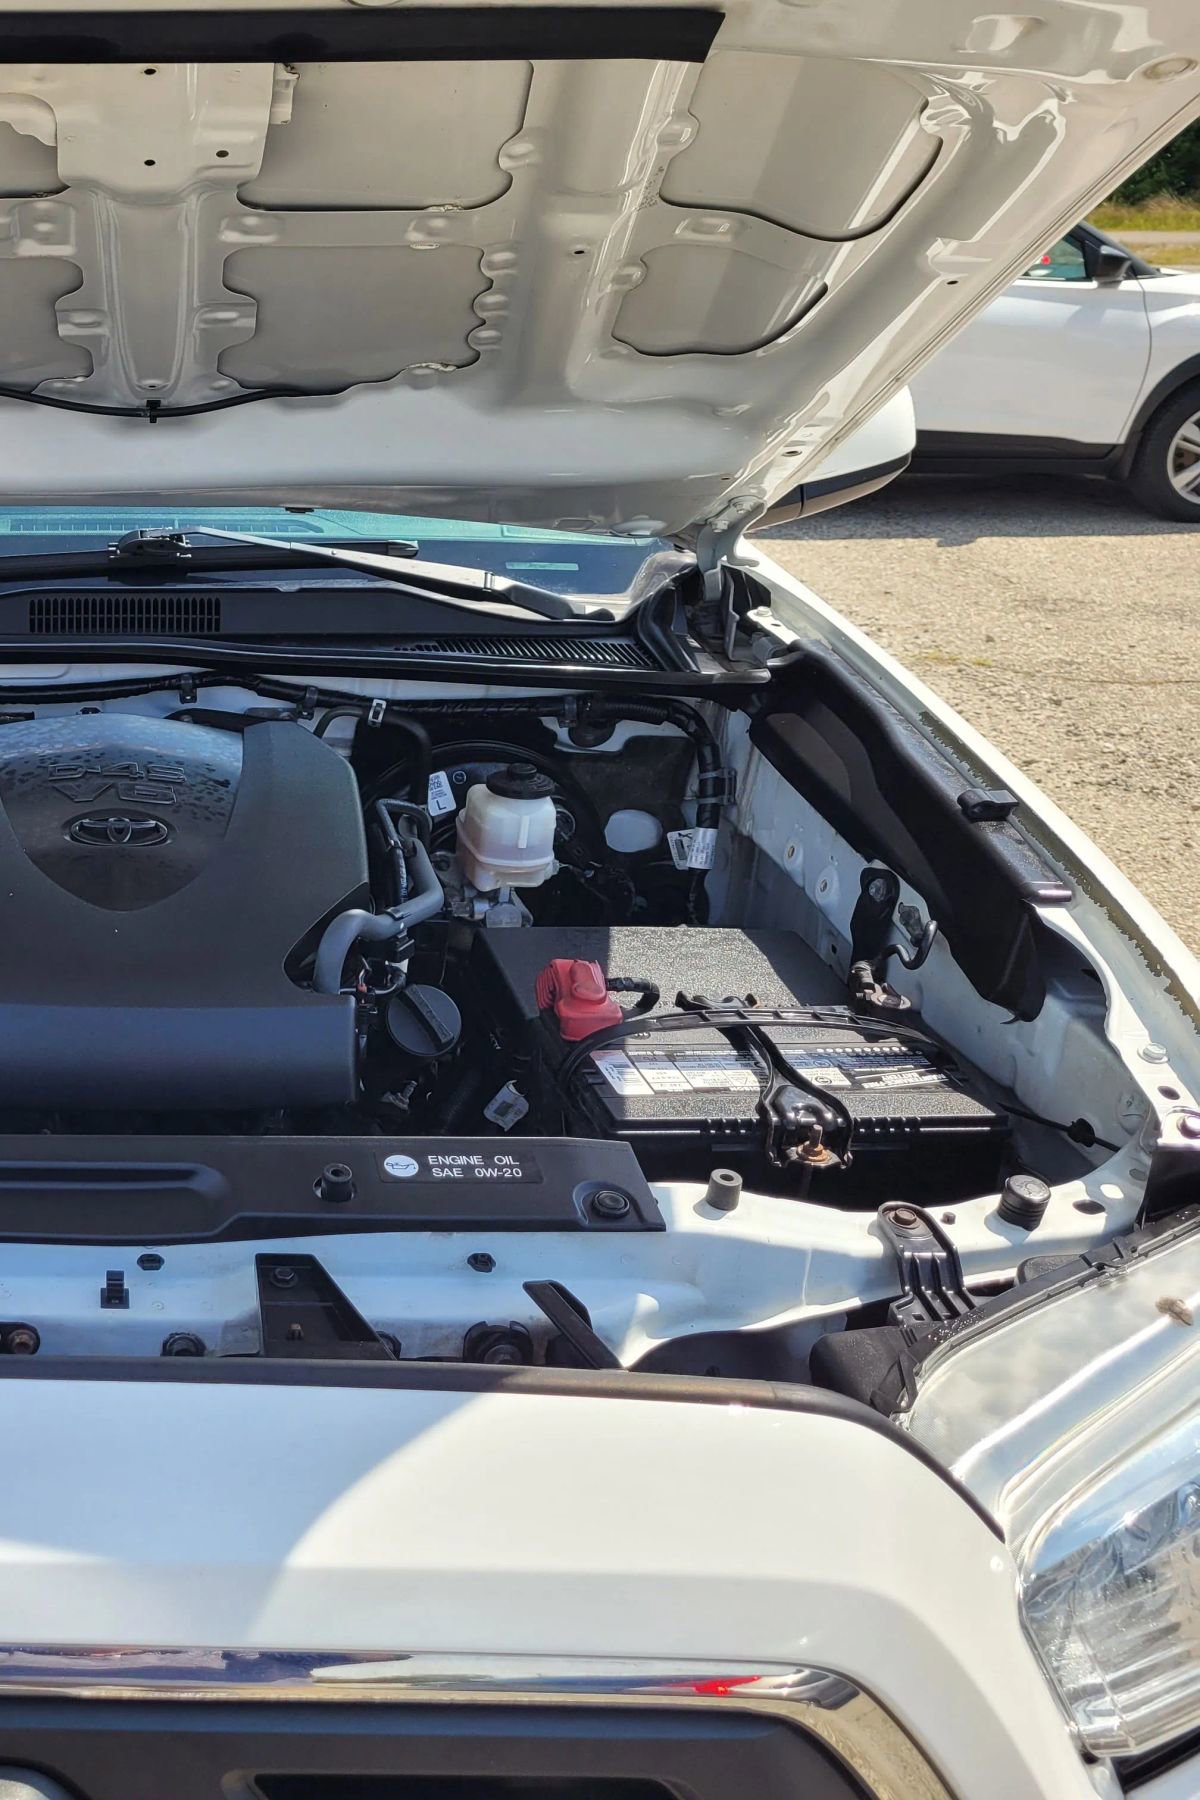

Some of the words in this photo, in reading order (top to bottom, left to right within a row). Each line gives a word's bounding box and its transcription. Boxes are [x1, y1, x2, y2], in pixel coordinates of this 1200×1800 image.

[47, 762, 187, 782] D-4S
[52, 781, 177, 805] V6
[436, 799, 447, 811] L
[427, 1155, 485, 1166] ENGINE
[494, 1155, 520, 1166] OIL
[431, 1167, 464, 1178] SAE
[474, 1167, 523, 1178] 0W-20
